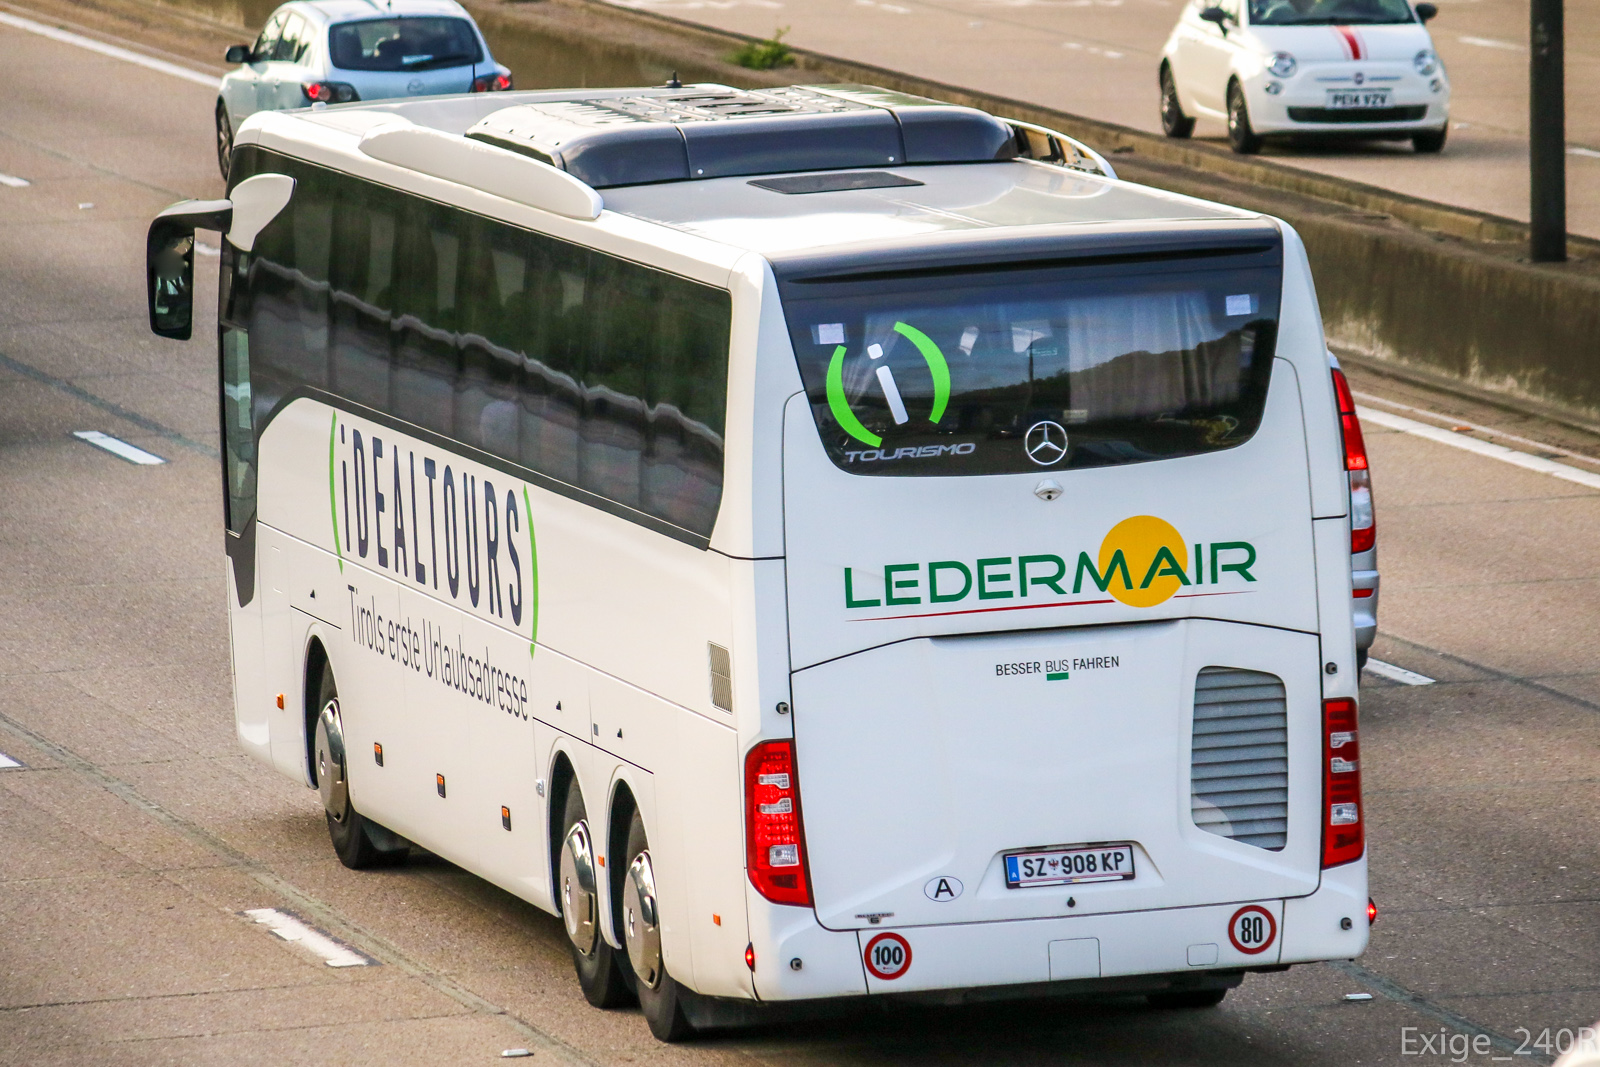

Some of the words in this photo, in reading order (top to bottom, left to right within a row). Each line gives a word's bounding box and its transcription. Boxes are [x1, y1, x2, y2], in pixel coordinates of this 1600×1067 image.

[845, 442, 977, 463] TOURISMO
[844, 540, 1258, 609] LEDERMAIR
[348, 585, 386, 656] Tirols
[388, 617, 421, 673] erste
[423, 618, 529, 722] Urlaubsadresse
[995, 661, 1042, 676] BESSER
[1045, 659, 1070, 673] BUS
[1073, 655, 1120, 671] FAHREN
[1022, 857, 1048, 878] SZ
[1060, 853, 1098, 875] 908
[1101, 851, 1125, 872] KP
[934, 878, 955, 899] A
[1241, 916, 1264, 944] 80
[874, 945, 903, 966] 100
